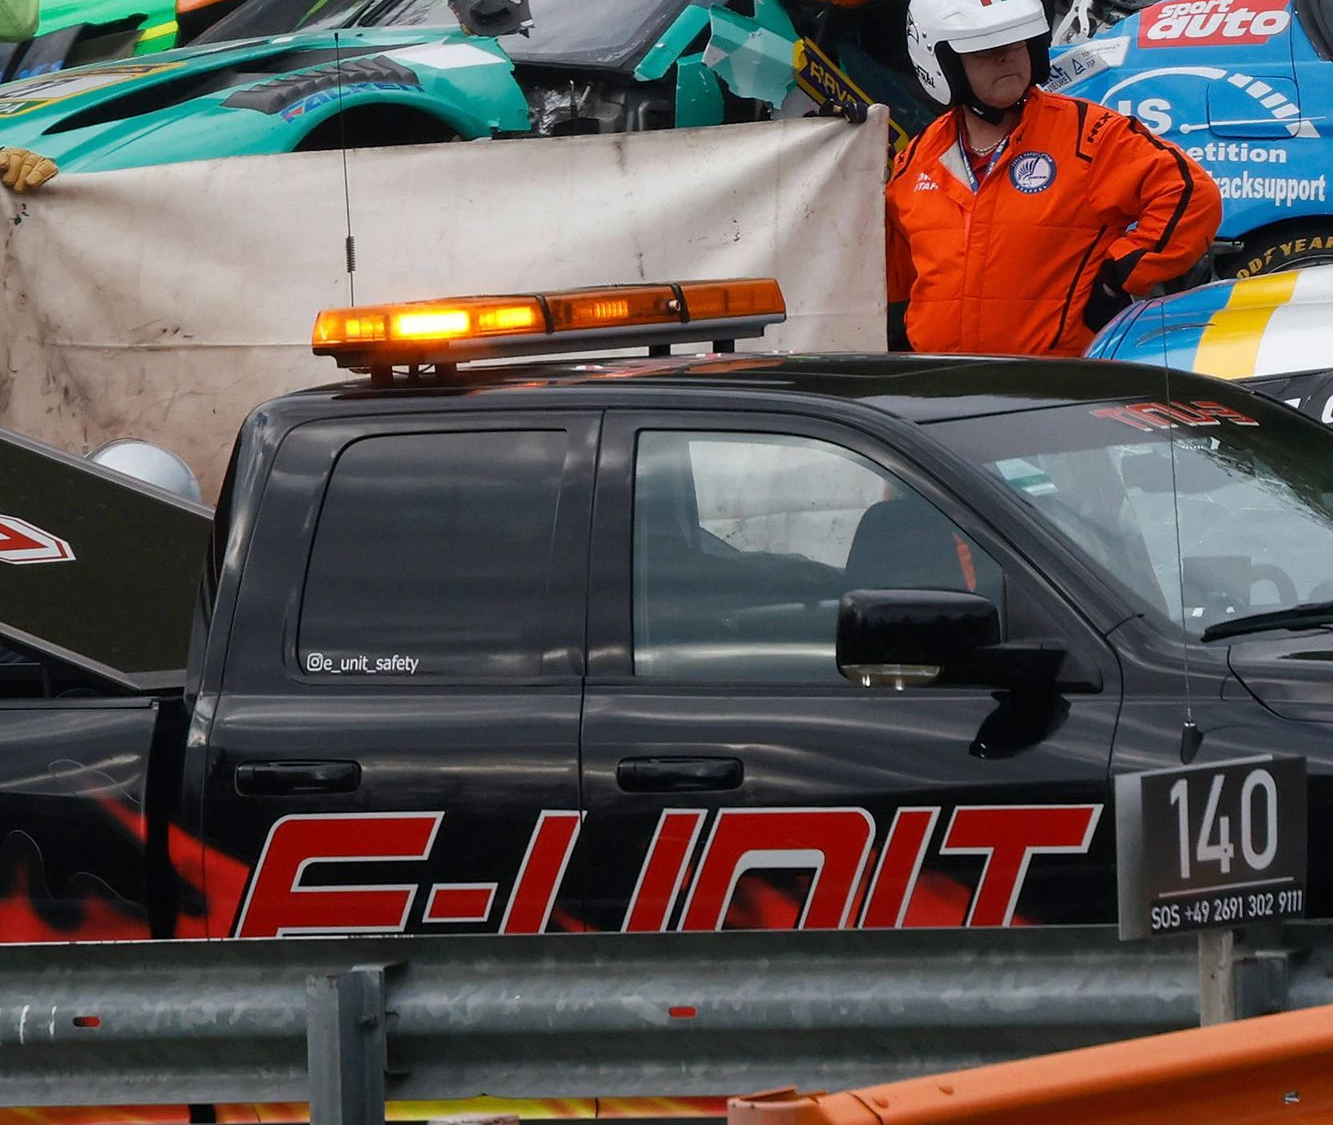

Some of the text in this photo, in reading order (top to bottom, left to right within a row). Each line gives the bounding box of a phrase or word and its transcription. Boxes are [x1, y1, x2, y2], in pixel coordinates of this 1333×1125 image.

[1146, 8, 1290, 40] auto
[1169, 768, 1278, 879] 140
[1151, 889, 1303, 931] SOS +49 2691 302 9111
